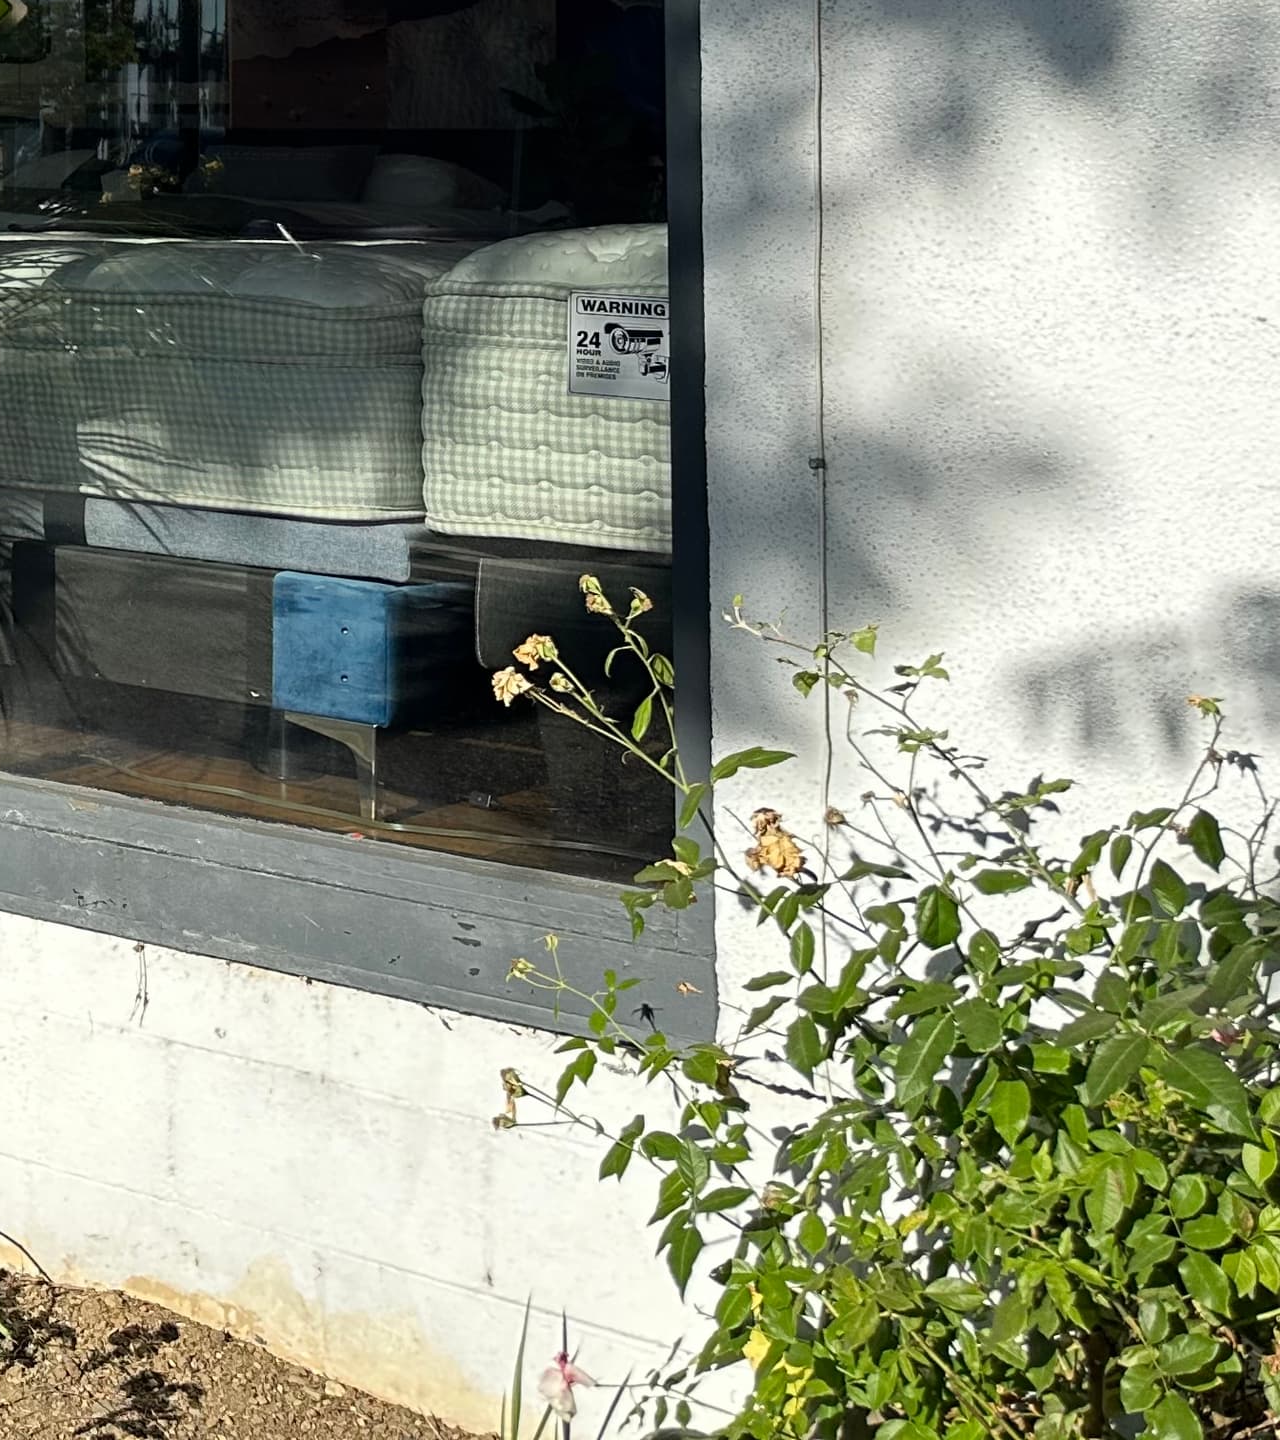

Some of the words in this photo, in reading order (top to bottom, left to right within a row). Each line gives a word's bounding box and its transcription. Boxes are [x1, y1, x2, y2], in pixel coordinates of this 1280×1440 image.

[581, 299, 666, 317] WARNING
[576, 330, 601, 349] 24
[576, 348, 601, 356] HOUR
